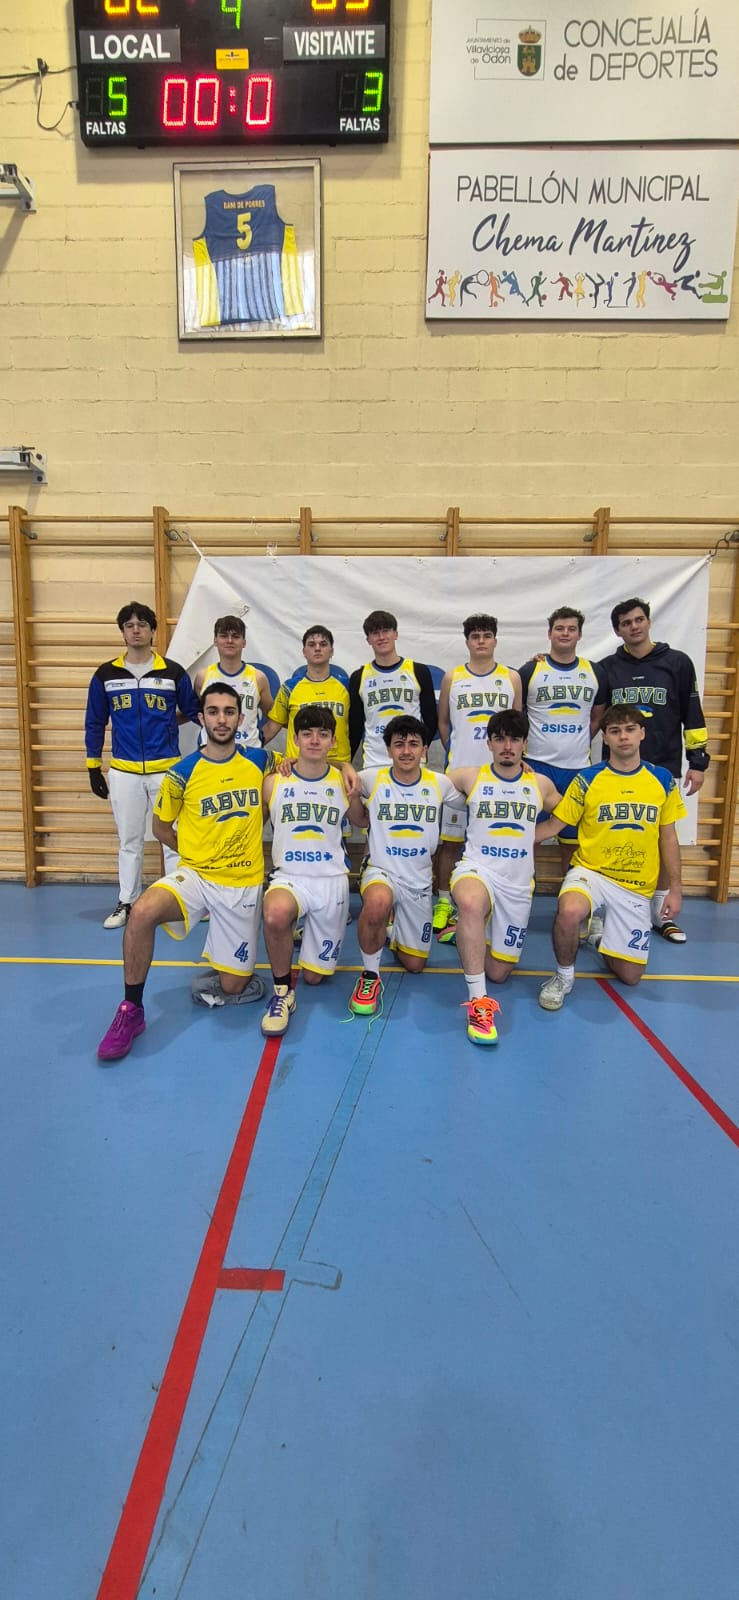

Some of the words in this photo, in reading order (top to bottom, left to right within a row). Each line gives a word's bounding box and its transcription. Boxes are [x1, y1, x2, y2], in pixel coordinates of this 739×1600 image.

[564, 8, 712, 48] CONCEJALÍA
[90, 33, 170, 60] LOCAL
[294, 30, 375, 56] VISITANTE
[553, 53, 579, 81] de
[589, 49, 719, 81] DEPORTES
[108, 76, 127, 116] 5
[362, 72, 383, 112] 3
[86, 121, 126, 136] FALTAS
[339, 117, 381, 132] FALTAS
[457, 170, 578, 204] PABELLÓN
[588, 174, 710, 204] MUNICIPAL
[236, 211, 253, 250] 5
[472, 212, 563, 256] Chema
[569, 216, 697, 273] Martínez
[367, 687, 414, 707] ABVO
[456, 692, 509, 710] ABVO
[536, 685, 595, 703] ABVO
[611, 686, 667, 706] ABVO
[473, 726, 488, 740] 27
[283, 787, 295, 798] 24
[482, 785, 494, 796] 55
[200, 788, 260, 818] ABVO
[281, 802, 341, 826] ABVO
[377, 803, 437, 823] ABVO
[476, 800, 537, 823] ABVO
[597, 802, 659, 823] ABVO
[421, 921, 432, 943] 8
[504, 924, 528, 949] 55
[233, 941, 249, 963] 4
